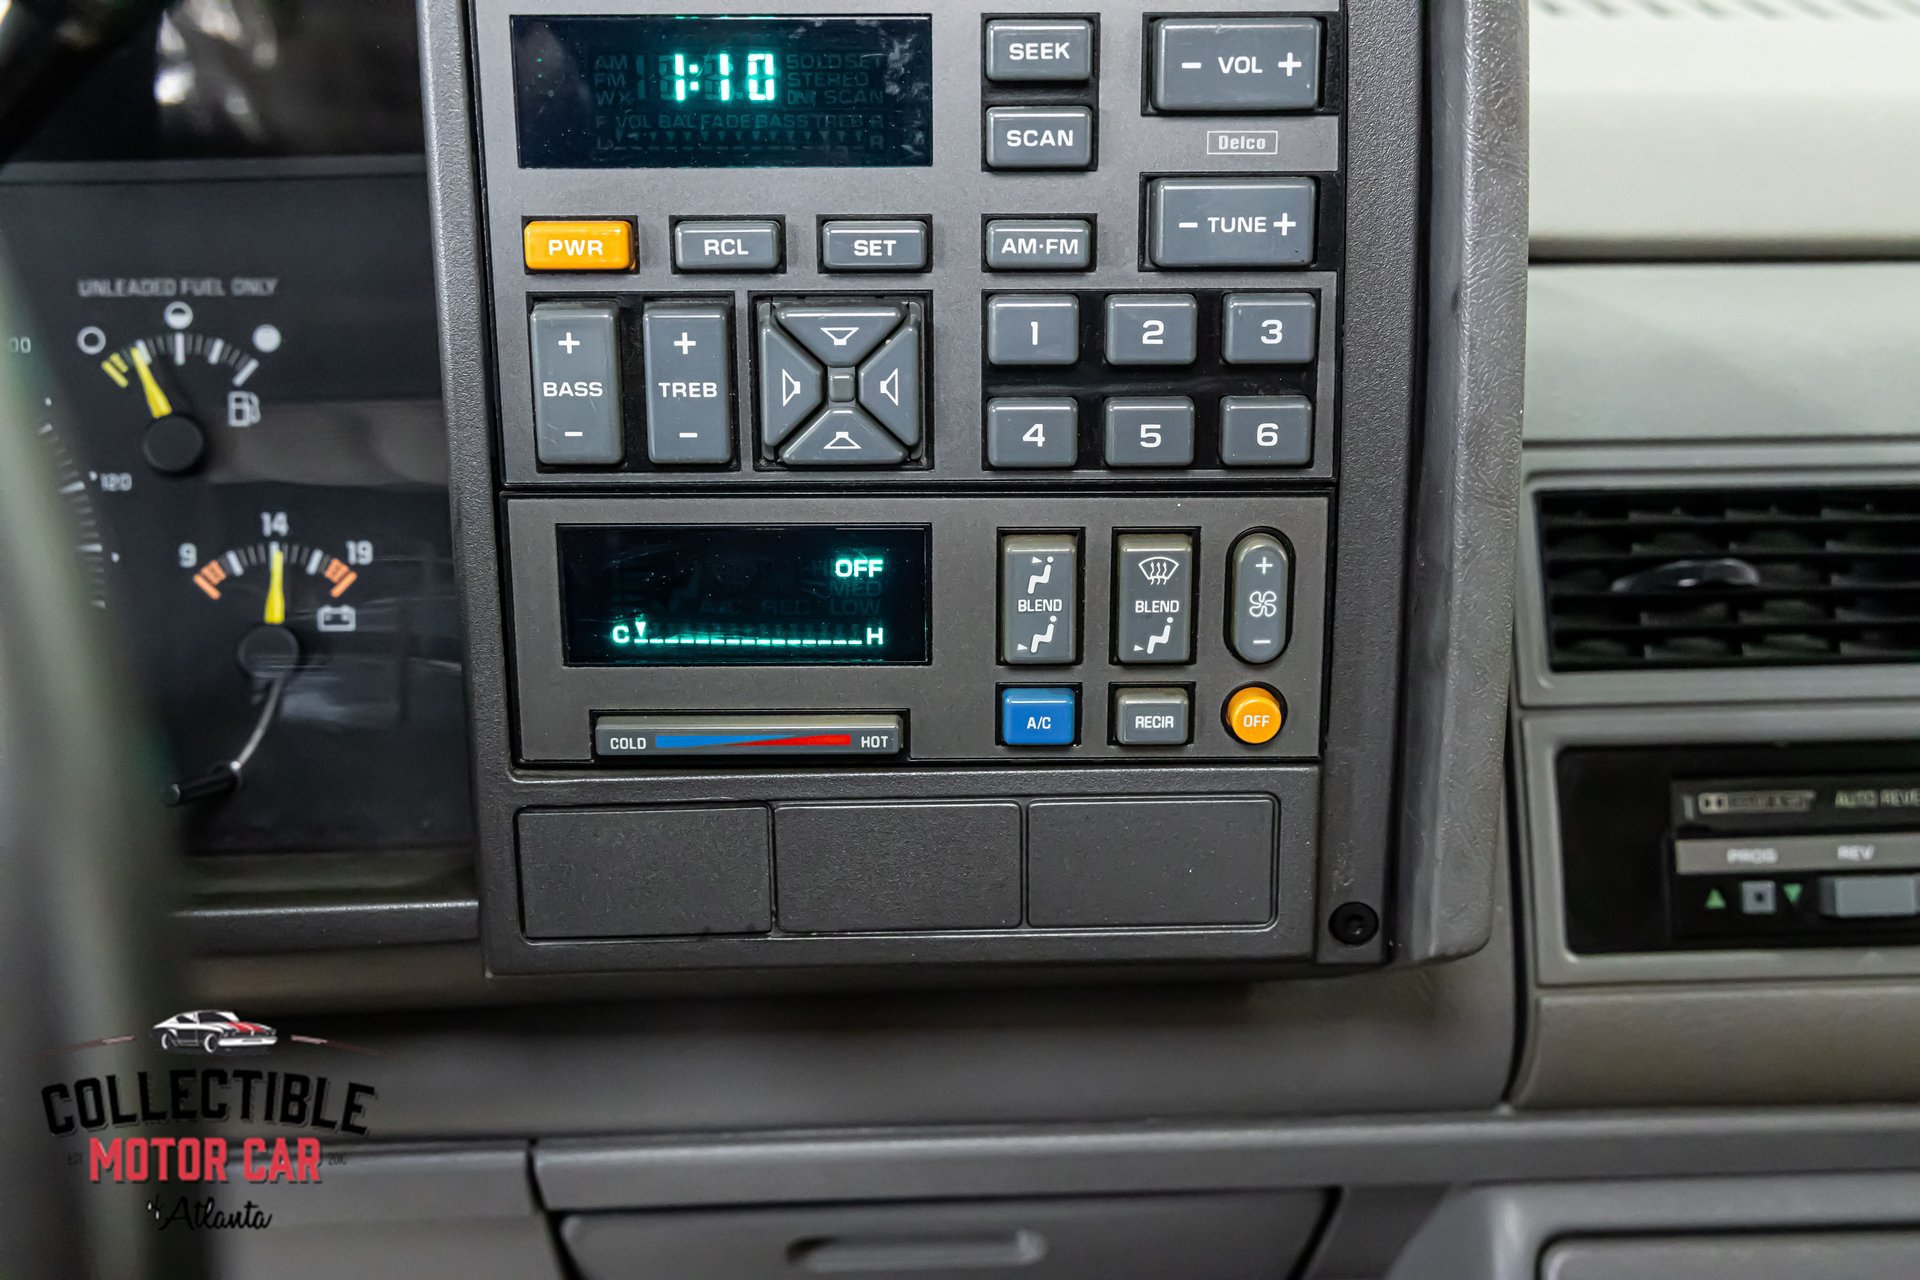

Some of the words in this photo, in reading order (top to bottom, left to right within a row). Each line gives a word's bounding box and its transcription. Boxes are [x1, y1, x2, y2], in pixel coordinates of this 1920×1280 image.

[1009, 43, 1070, 60] SEEK
[1218, 56, 1263, 74] VOL
[675, 53, 775, 102] 1:10
[787, 72, 870, 87] STEREO
[1006, 130, 1073, 147] SCAN
[1218, 135, 1266, 150] Delco
[1208, 217, 1267, 234] TUNE
[548, 239, 604, 256] PWR
[704, 238, 749, 256] RCL
[853, 239, 897, 257] SET
[78, 279, 176, 297] UNLEADED
[180, 278, 226, 297] FUEL
[231, 277, 277, 296] ONLY
[1030, 321, 1038, 346] 1
[1142, 320, 1165, 345] 2
[1260, 319, 1283, 345] 3
[543, 381, 603, 398] BASS
[658, 382, 718, 398] TREB
[1022, 423, 1045, 447] 4
[1140, 424, 1162, 448] 5
[1256, 423, 1278, 447] 6
[261, 512, 289, 536] 14
[179, 543, 197, 567] 9
[346, 541, 373, 564] 19
[835, 559, 883, 577] OFF
[1018, 599, 1062, 613] BLEND
[1135, 600, 1179, 613] BLEND
[612, 625, 630, 644] C
[866, 627, 884, 645] H
[1027, 717, 1051, 730] A/C
[1135, 716, 1174, 729] RECIR
[1243, 715, 1270, 729] OFF
[610, 737, 647, 750] COLD
[861, 736, 889, 749] HOT
[1837, 845, 1875, 861] REV
